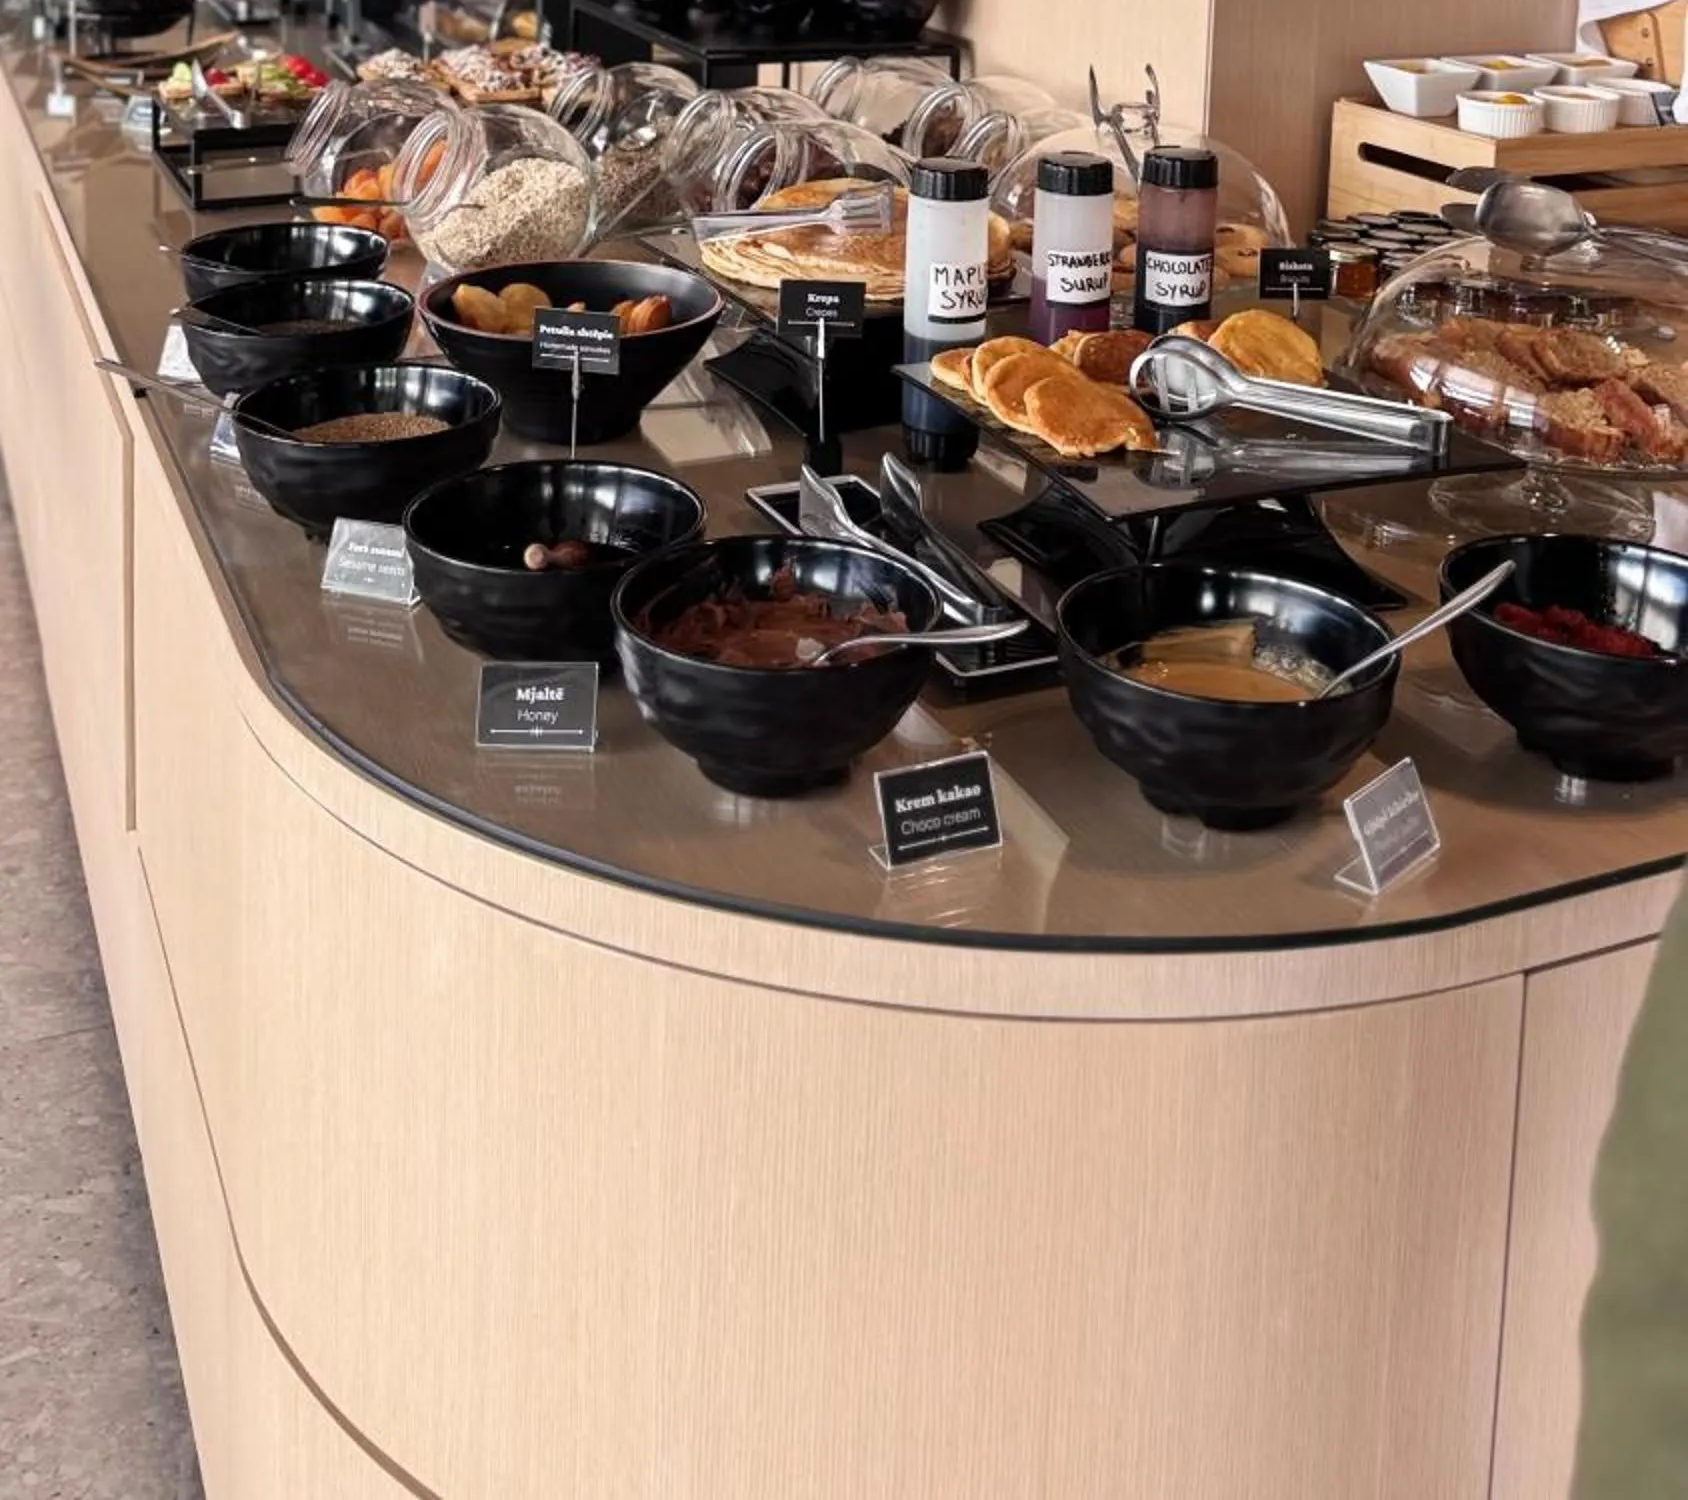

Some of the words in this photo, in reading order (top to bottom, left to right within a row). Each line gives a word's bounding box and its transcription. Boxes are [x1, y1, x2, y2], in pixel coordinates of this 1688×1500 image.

[935, 266, 985, 286] MAPL
[940, 289, 986, 310] SYRU
[1155, 280, 1206, 299] SYRUP
[516, 686, 565, 705] Mjaltë
[517, 709, 559, 725] Honey
[895, 795, 936, 814] Krem
[936, 784, 982, 804] kakao
[901, 817, 941, 835] Choco
[943, 808, 981, 826] cream
